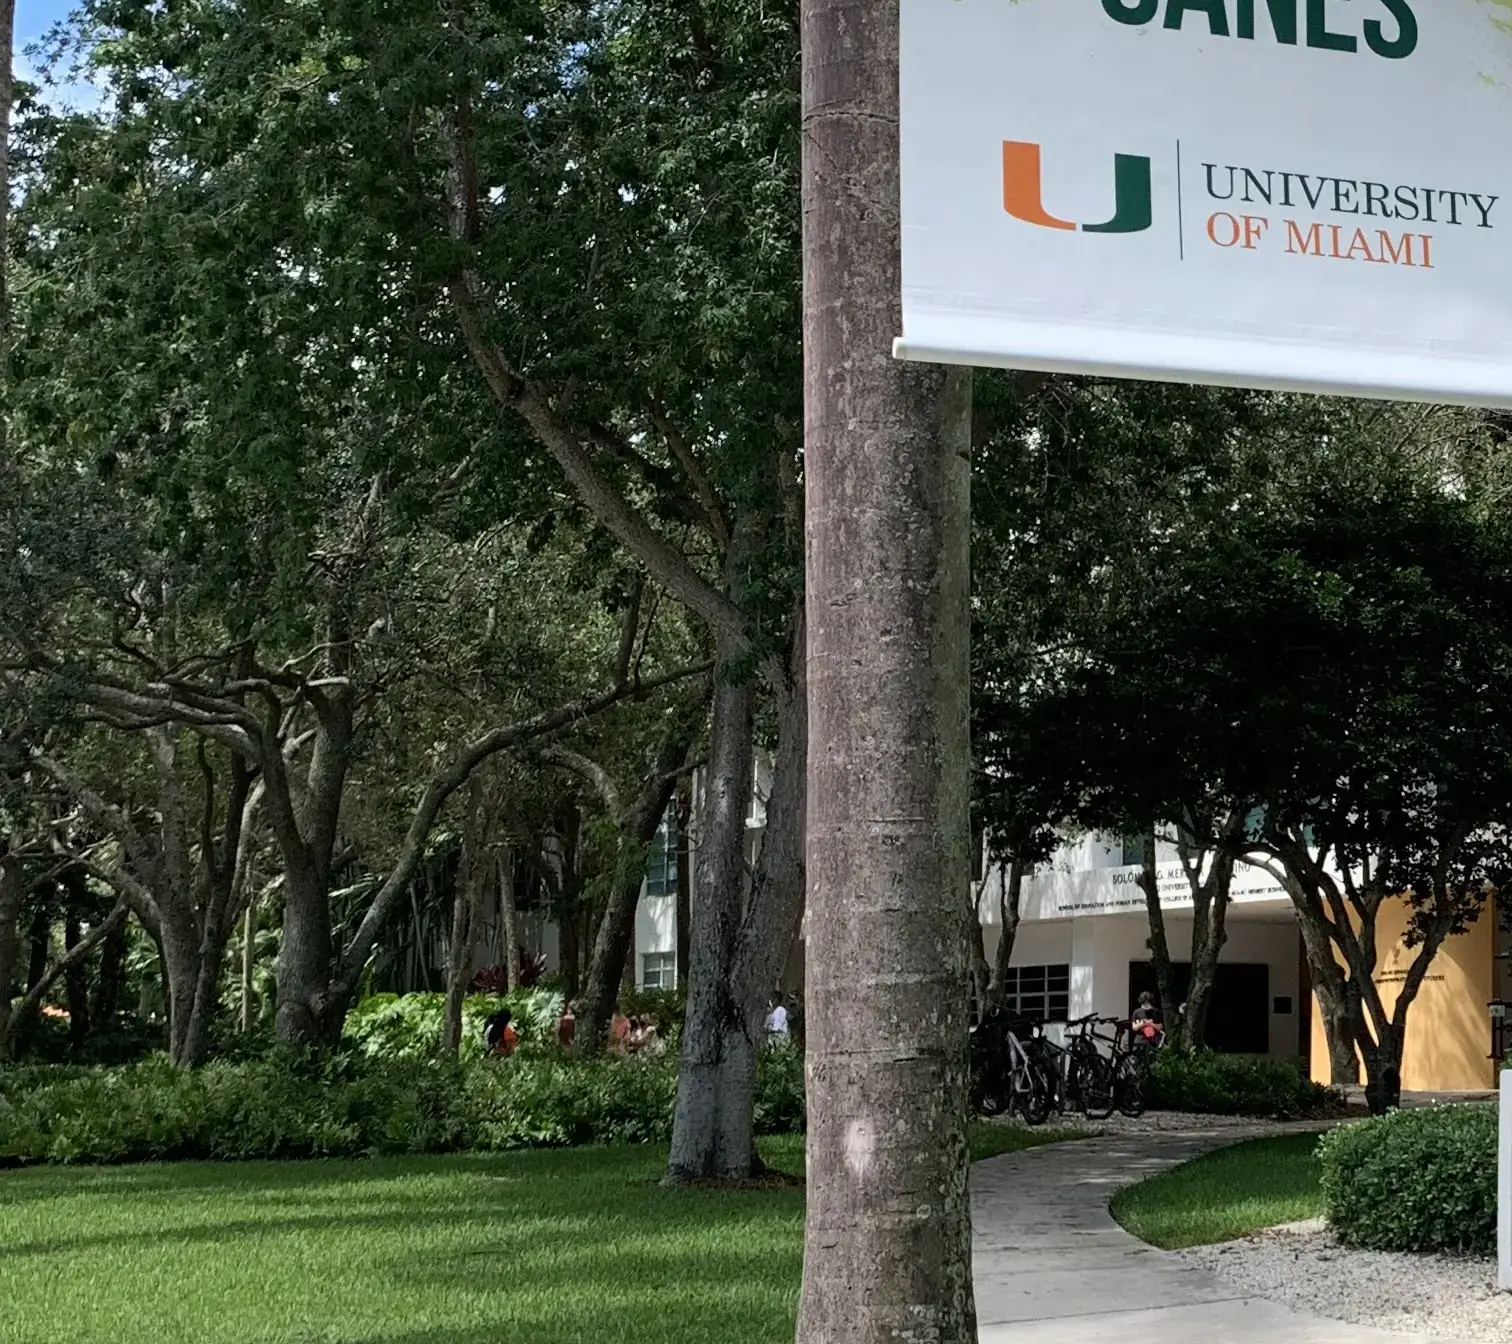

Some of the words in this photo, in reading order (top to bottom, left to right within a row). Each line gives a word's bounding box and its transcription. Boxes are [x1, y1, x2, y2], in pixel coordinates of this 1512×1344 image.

[1201, 163, 1500, 229] UNIVERSITY
[1207, 212, 1269, 251] OF
[1284, 220, 1435, 269] MIAMI
